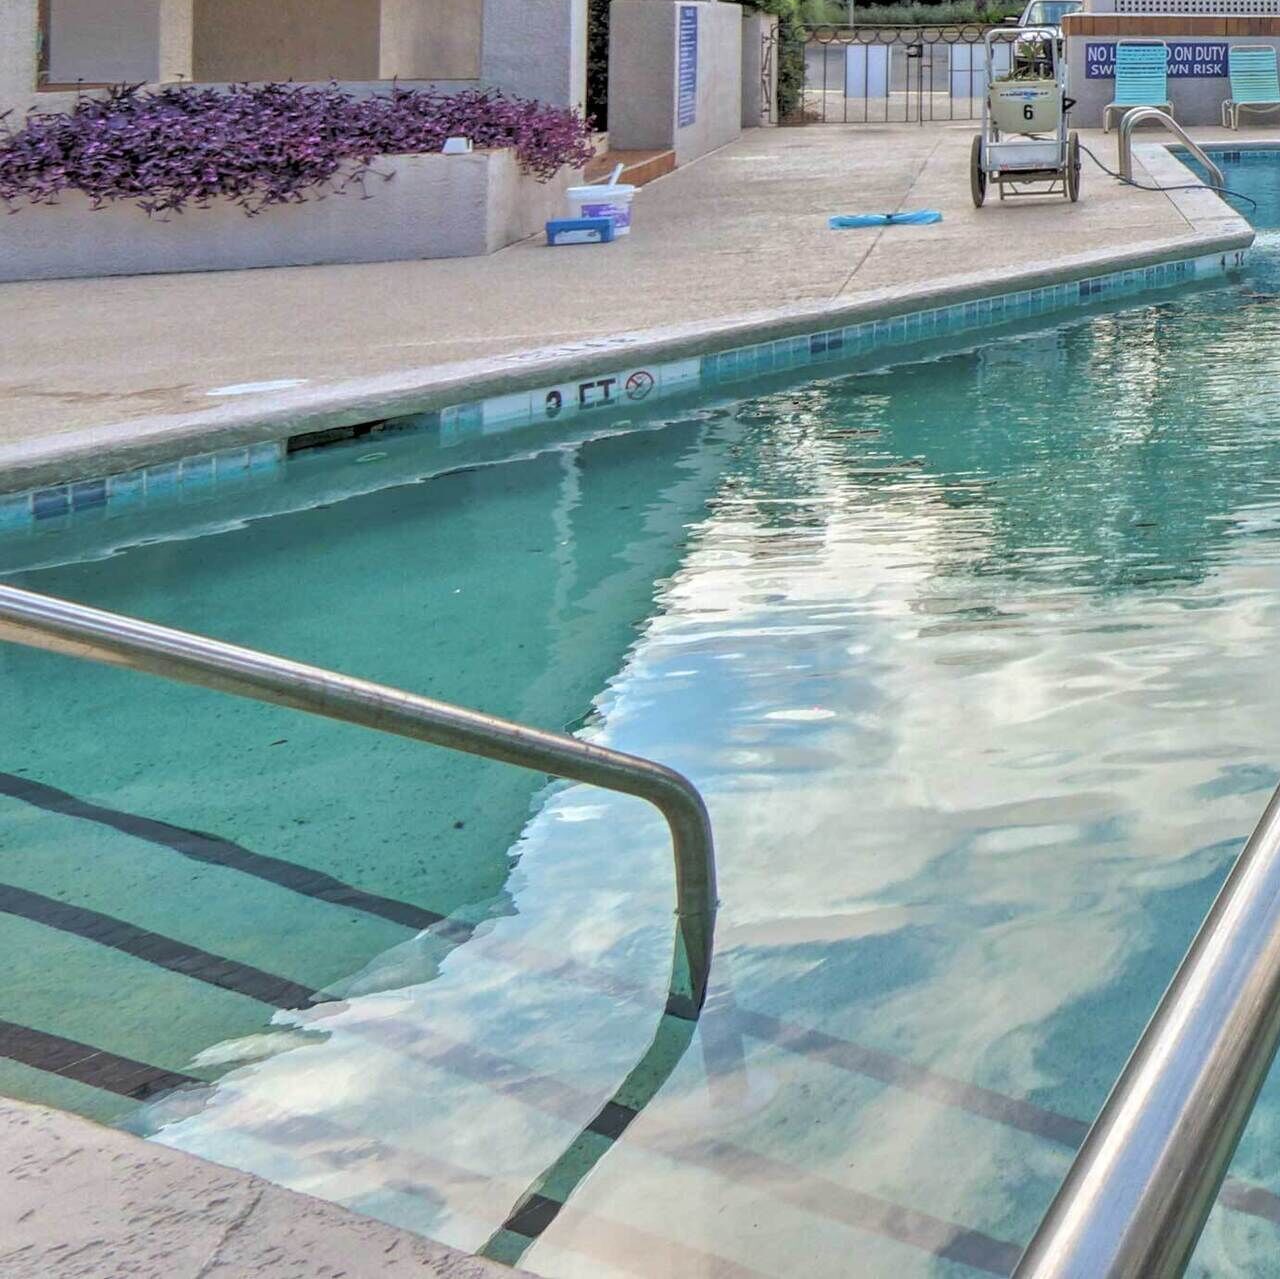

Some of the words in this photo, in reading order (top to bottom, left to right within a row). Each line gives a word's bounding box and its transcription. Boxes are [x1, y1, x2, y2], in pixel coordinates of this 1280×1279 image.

[1087, 46, 1107, 62] NO
[1174, 46, 1192, 62] ON
[1195, 45, 1226, 61] DUTY
[1193, 63, 1222, 75] RISK
[1023, 104, 1033, 120] 6
